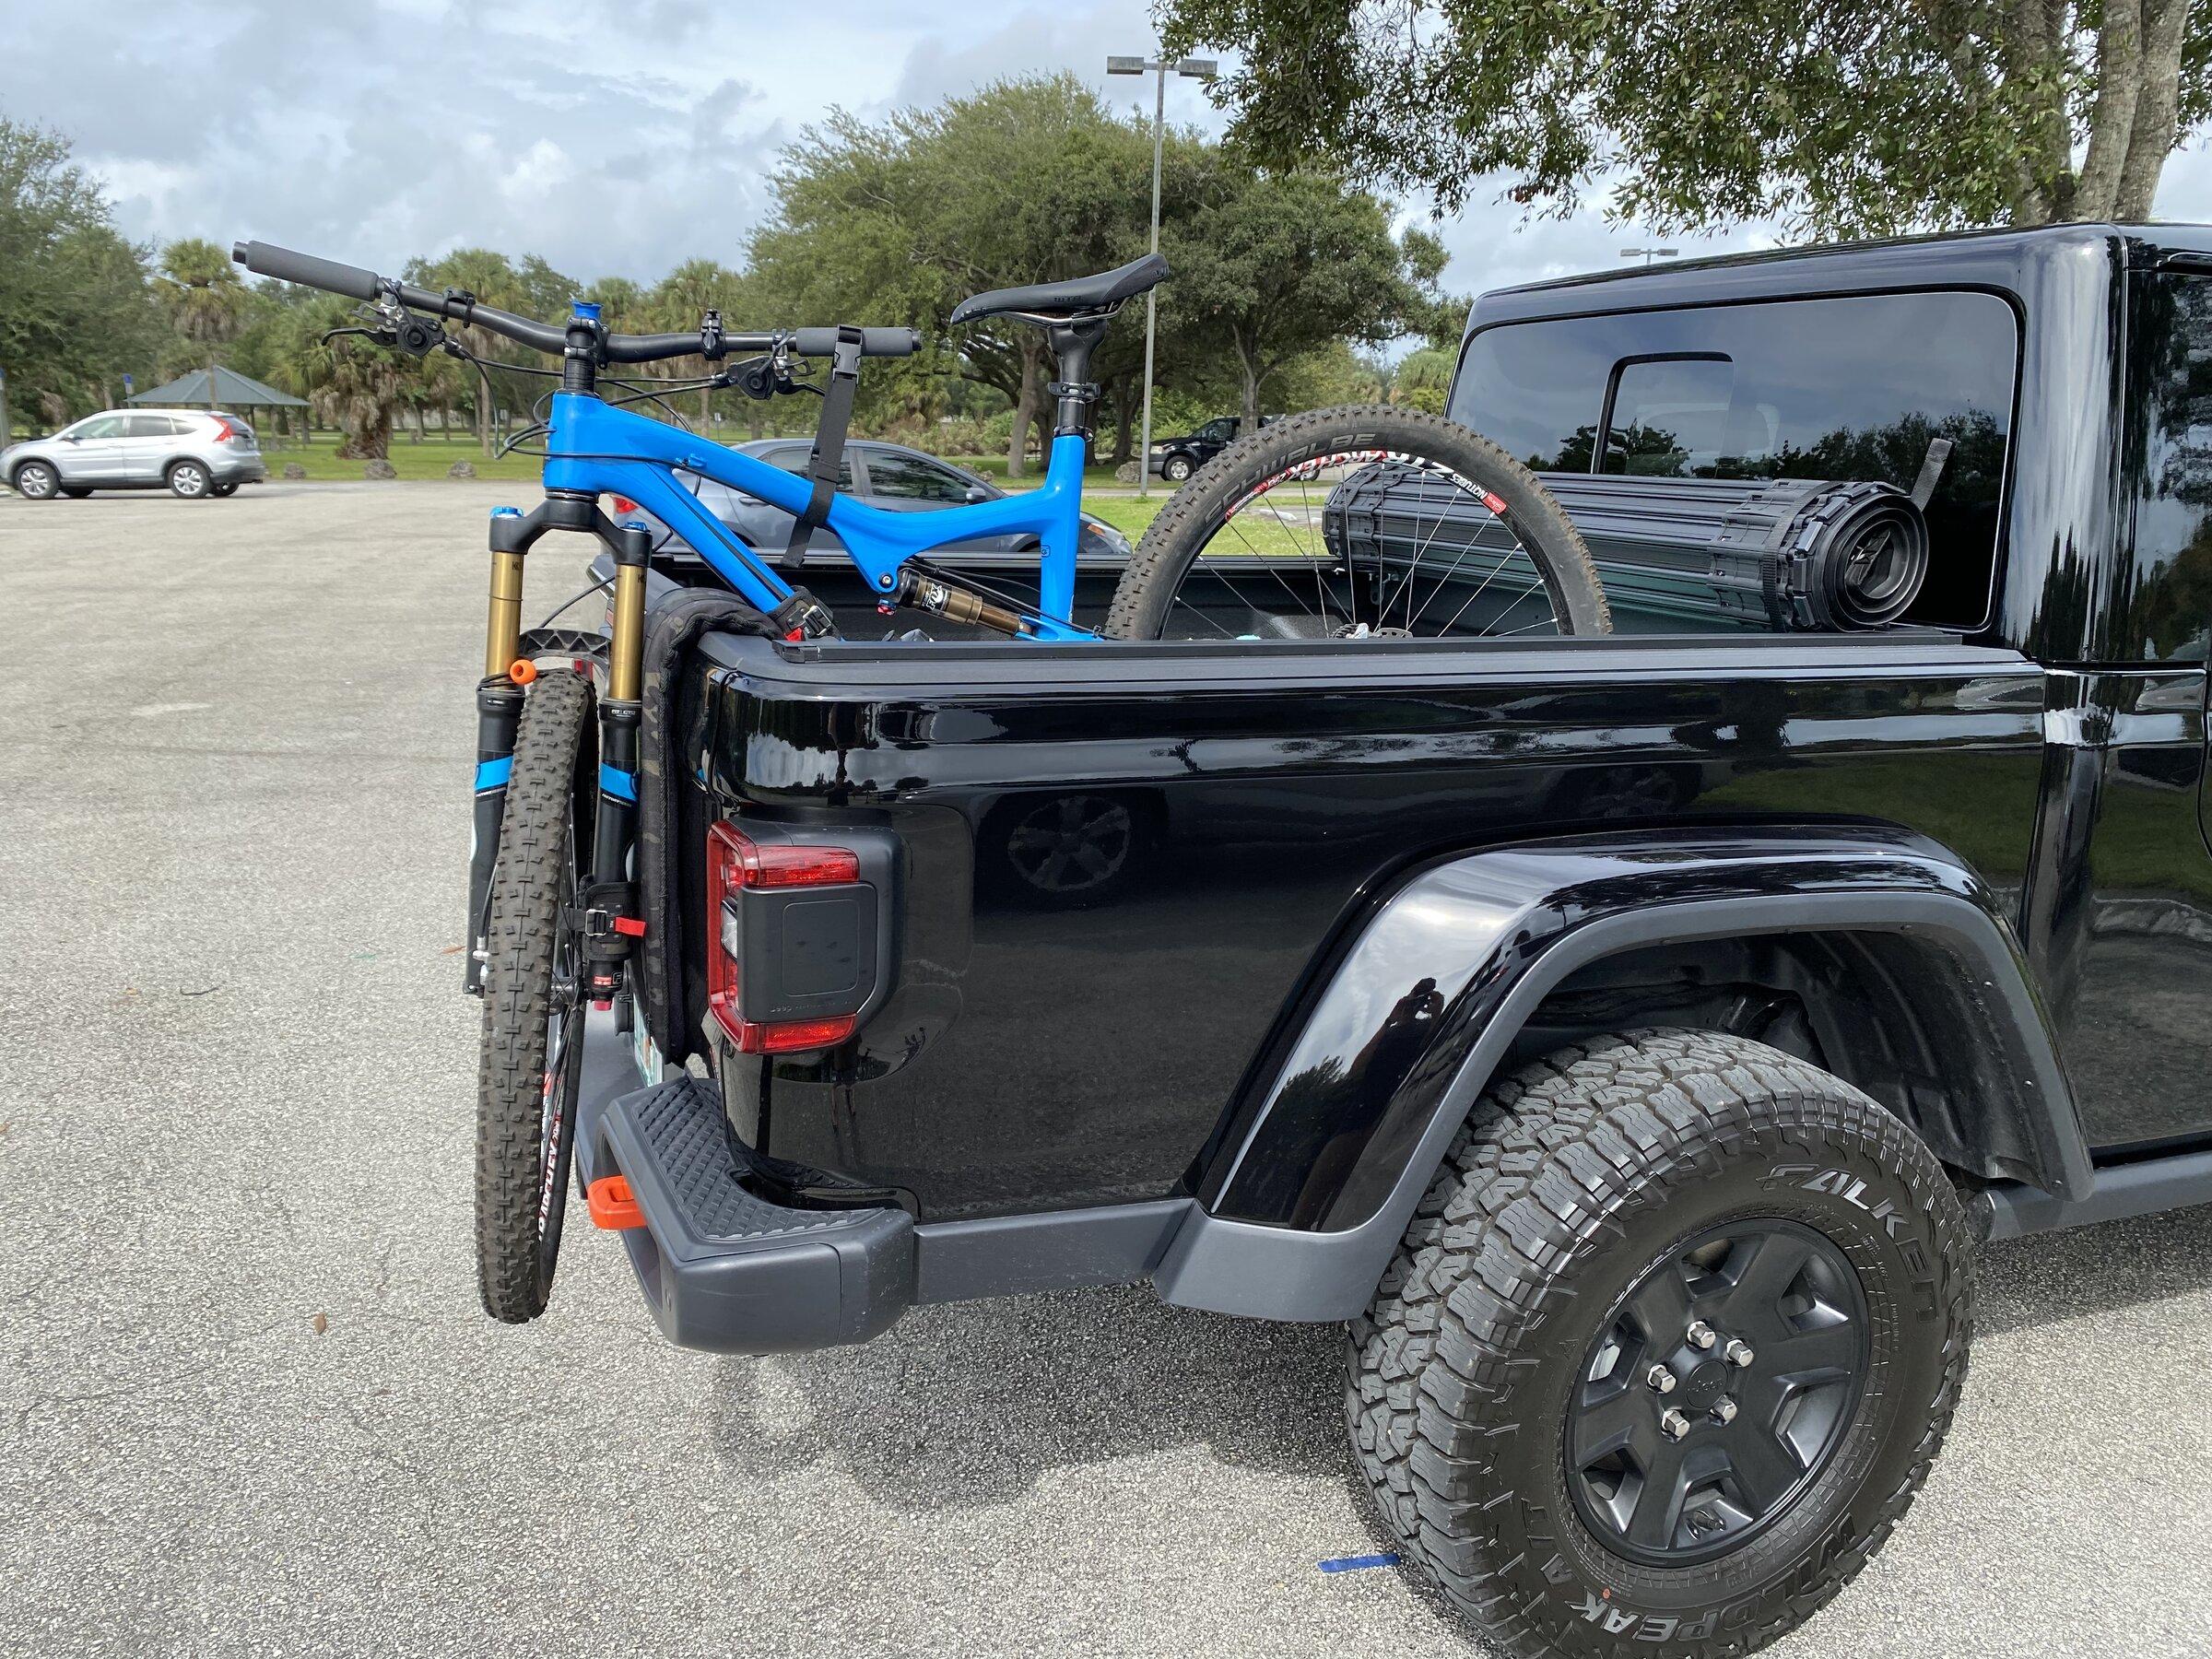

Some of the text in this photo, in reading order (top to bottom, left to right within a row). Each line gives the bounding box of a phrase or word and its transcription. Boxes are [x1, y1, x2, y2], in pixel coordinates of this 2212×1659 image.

[1206, 433, 1376, 524] SCHWALBE
[1450, 473, 1488, 500] NOTUBES
[1755, 1163, 1939, 1324] FALKEN
[1564, 1512, 1857, 1641] WILDPEAK
